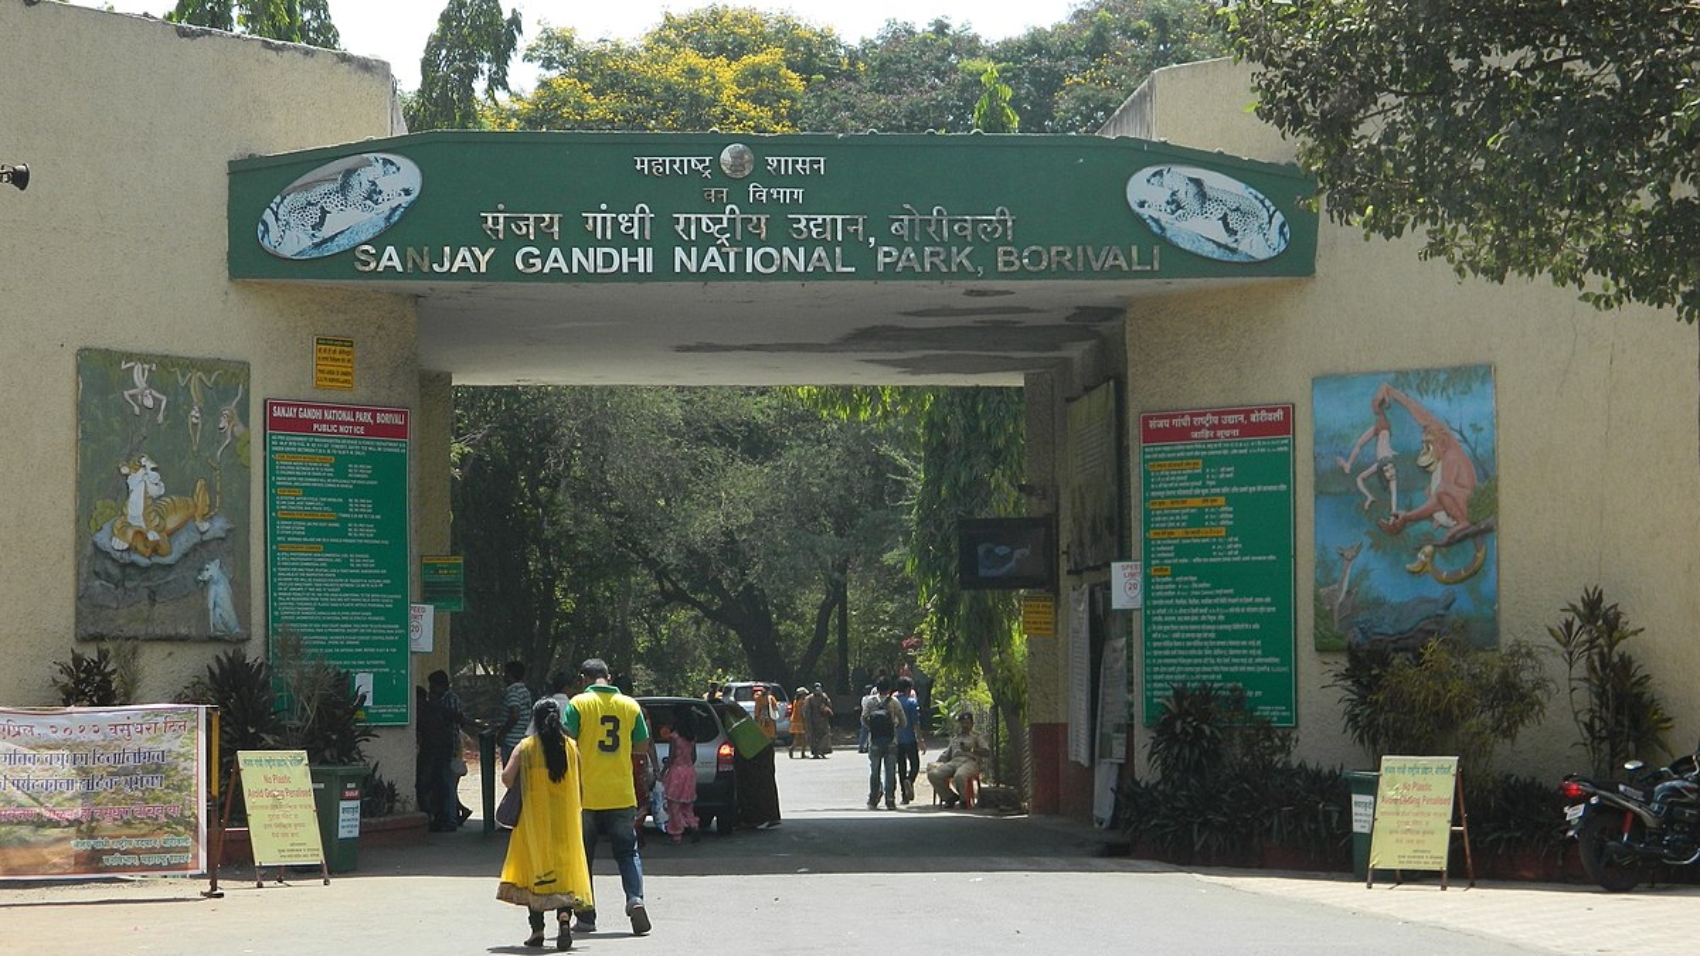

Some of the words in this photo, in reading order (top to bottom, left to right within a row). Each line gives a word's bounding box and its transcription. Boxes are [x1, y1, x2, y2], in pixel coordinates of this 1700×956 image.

[633, 156, 713, 179] महाराष्ट्र
[765, 156, 826, 176] शासन
[702, 187, 729, 203] वन
[748, 183, 804, 204] विभाग
[479, 203, 563, 240] संजय
[581, 203, 655, 241] गांधी
[672, 204, 769, 247] राष्ट्रीय
[787, 213, 876, 248] उद्यान,
[889, 203, 1016, 243] बोरीवली
[354, 244, 496, 274] SANJAY
[515, 245, 652, 274] GANDHI
[674, 245, 855, 274] NATIONAL
[877, 244, 983, 277] PARK,
[996, 244, 1160, 273] BORIVALI
[272, 406, 298, 418] SANJAY
[298, 407, 323, 420] GANDHI
[324, 409, 354, 422] NATIONAL
[376, 413, 405, 425] BORIVALI
[313, 423, 337, 433] PUBLIC
[339, 425, 365, 434] NOTICE
[1128, 581, 1138, 590] 20
[108, 716, 159, 742] वसुंधरा
[598, 715, 620, 753] 3
